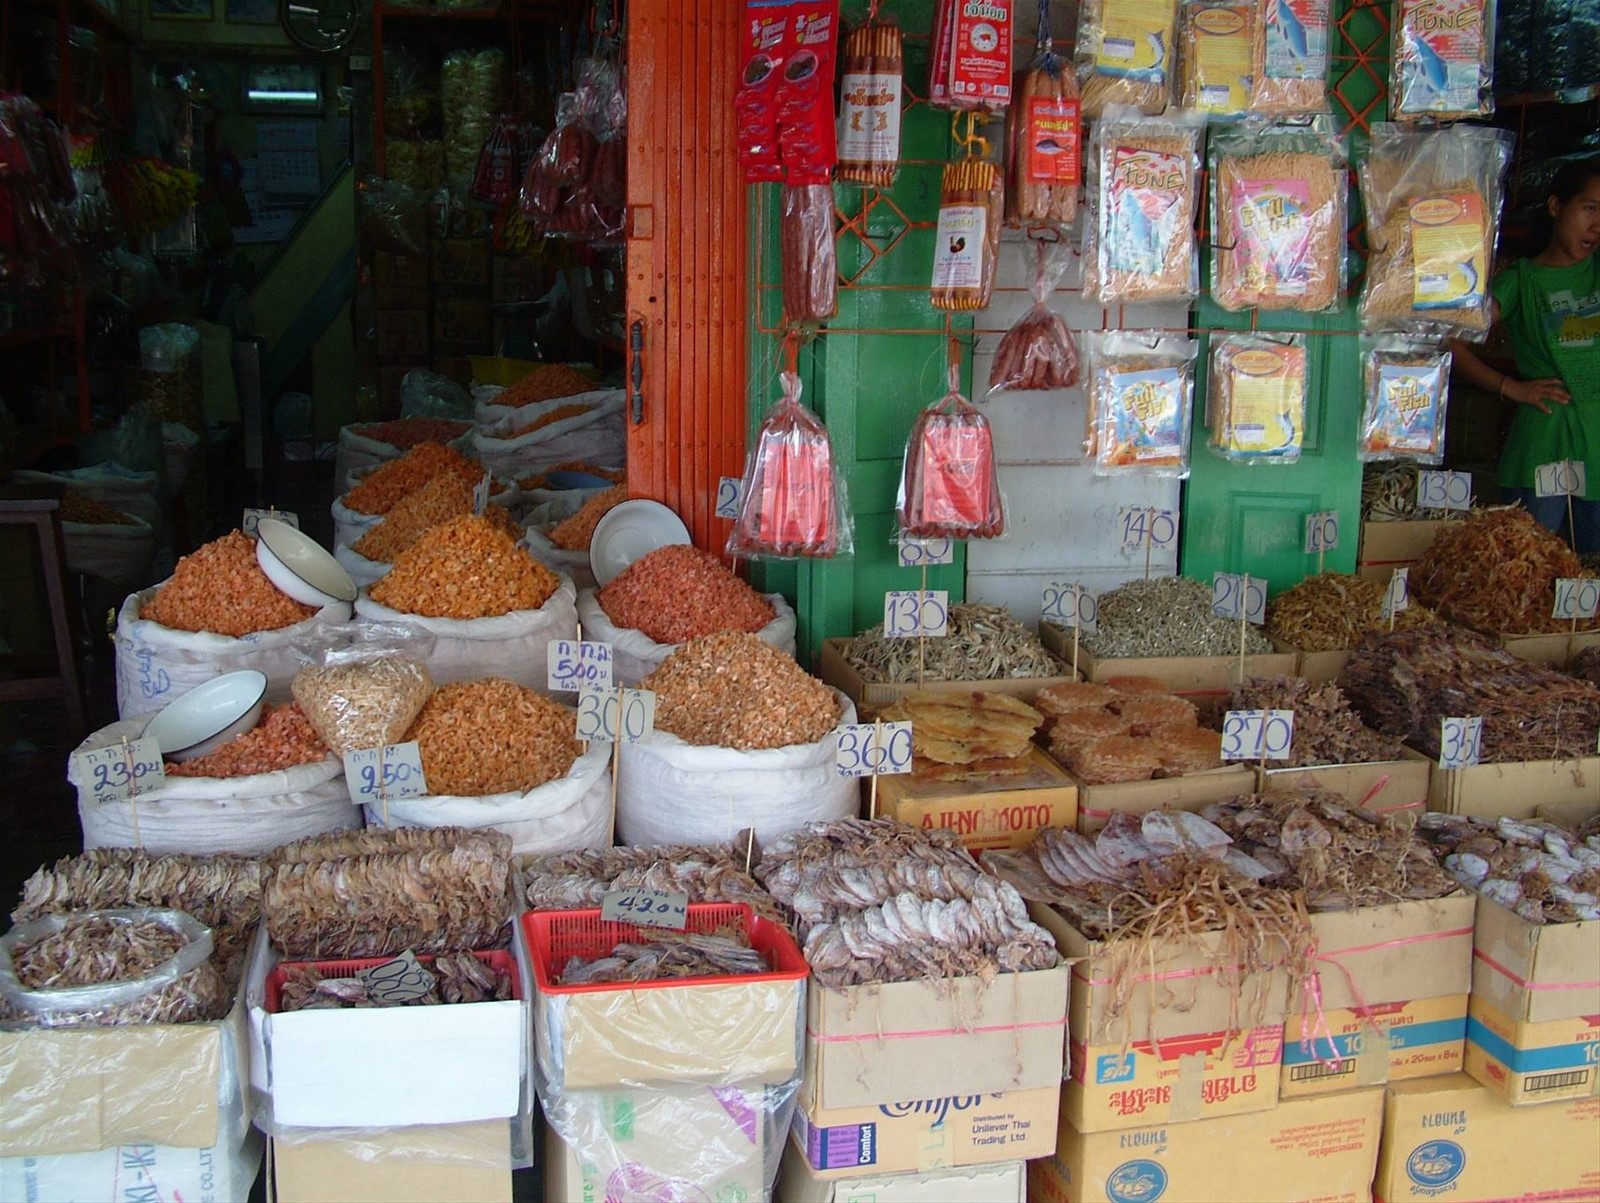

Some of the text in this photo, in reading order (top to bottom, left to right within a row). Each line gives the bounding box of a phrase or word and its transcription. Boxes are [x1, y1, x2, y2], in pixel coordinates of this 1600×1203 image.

[1407, 1, 1479, 32] FUNE
[1120, 155, 1185, 190] FUNE
[1421, 474, 1469, 504] 130
[1536, 466, 1579, 493] 110
[1124, 511, 1174, 544] 140
[1307, 518, 1338, 549] 160
[1041, 588, 1096, 623] 200
[1213, 577, 1263, 616] 210
[1556, 584, 1597, 614] 160
[888, 597, 945, 632] 130
[552, 659, 598, 680] 500
[579, 694, 645, 738] 300
[837, 728, 912, 769] 360
[1222, 716, 1290, 754] 370
[94, 762, 147, 791] 230
[360, 763, 411, 794] 250
[972, 1120, 1031, 1133] Unilever Thai
[973, 1114, 1006, 1122] Distributed
[860, 1125, 872, 1163] Comfort
[973, 1134, 1006, 1146] Trading
